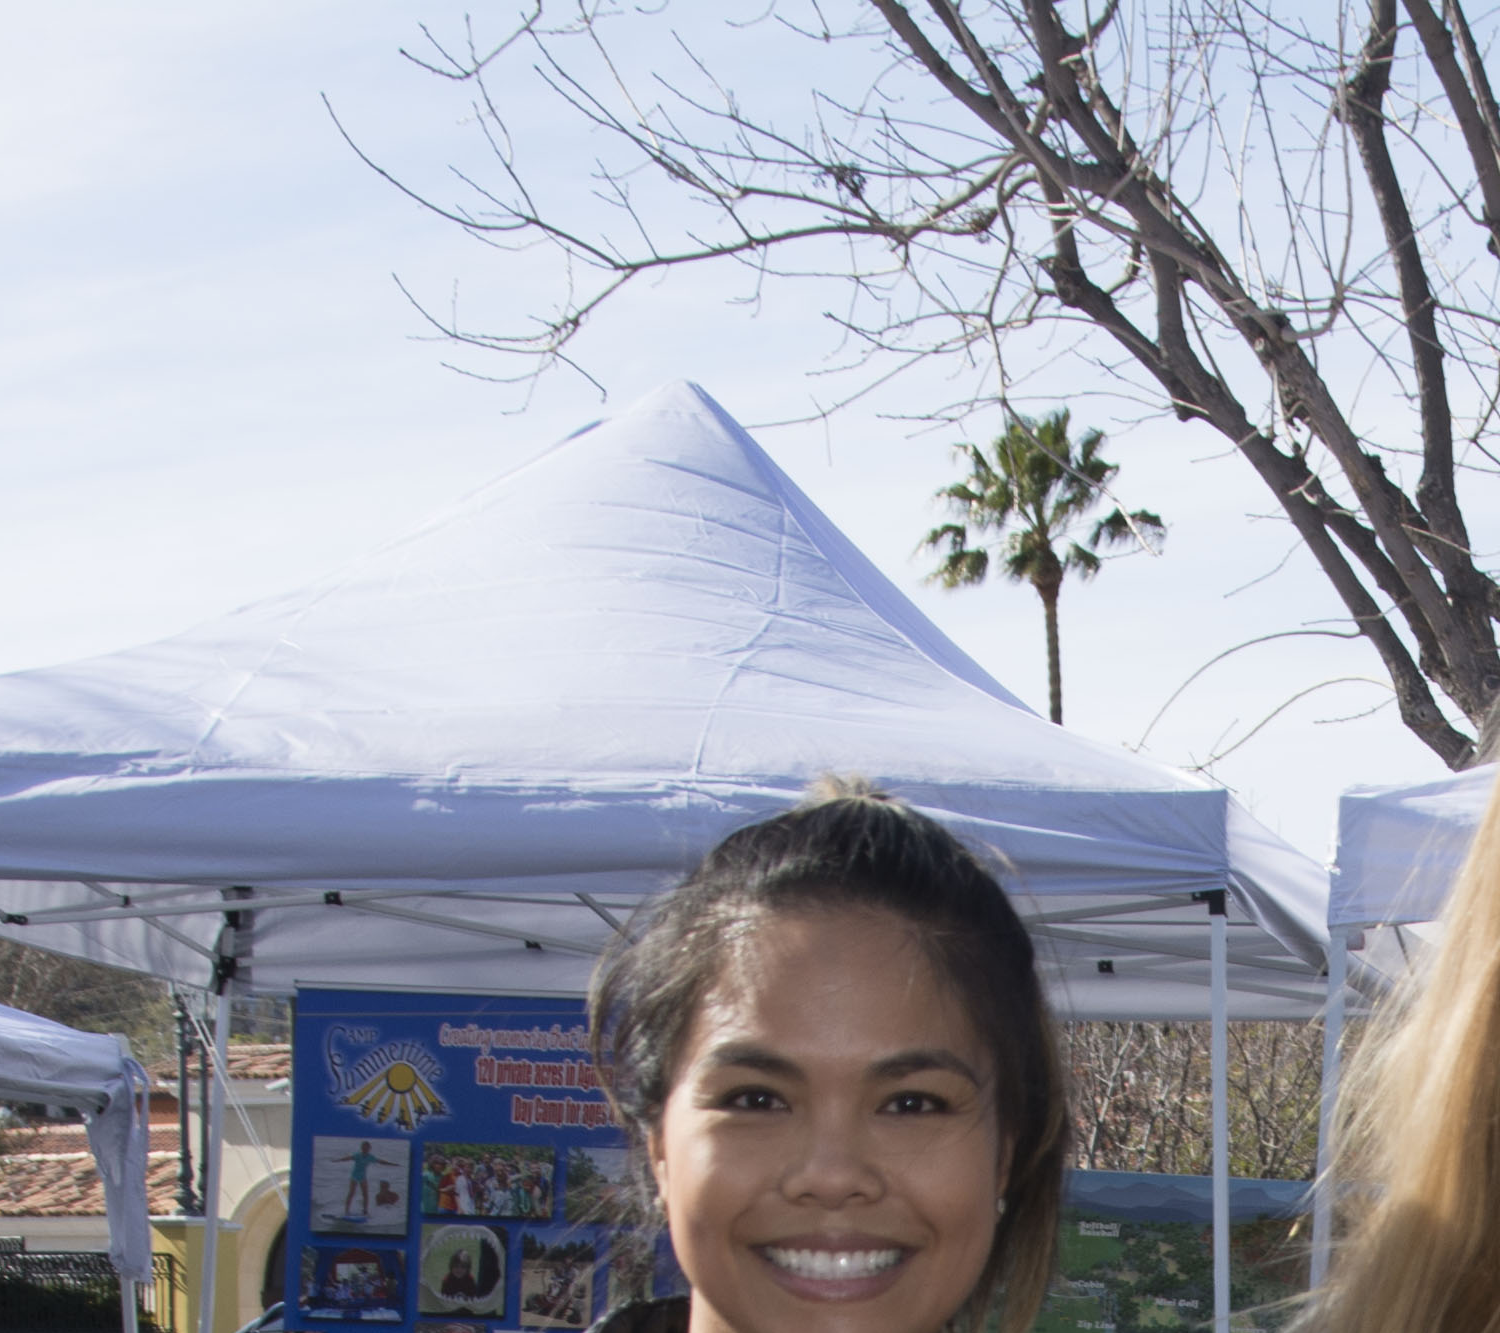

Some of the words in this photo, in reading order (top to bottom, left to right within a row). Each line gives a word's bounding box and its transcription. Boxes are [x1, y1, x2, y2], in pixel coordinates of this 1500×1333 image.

[440, 1022, 493, 1056] Creating
[496, 1057, 533, 1087] private
[533, 1062, 564, 1086] acres
[565, 1058, 577, 1086] in
[513, 1094, 533, 1127] Day
[534, 1095, 565, 1126] Camp
[566, 1097, 580, 1123] for
[582, 1102, 606, 1128] ages
[1077, 1319, 1095, 1330] Zip
